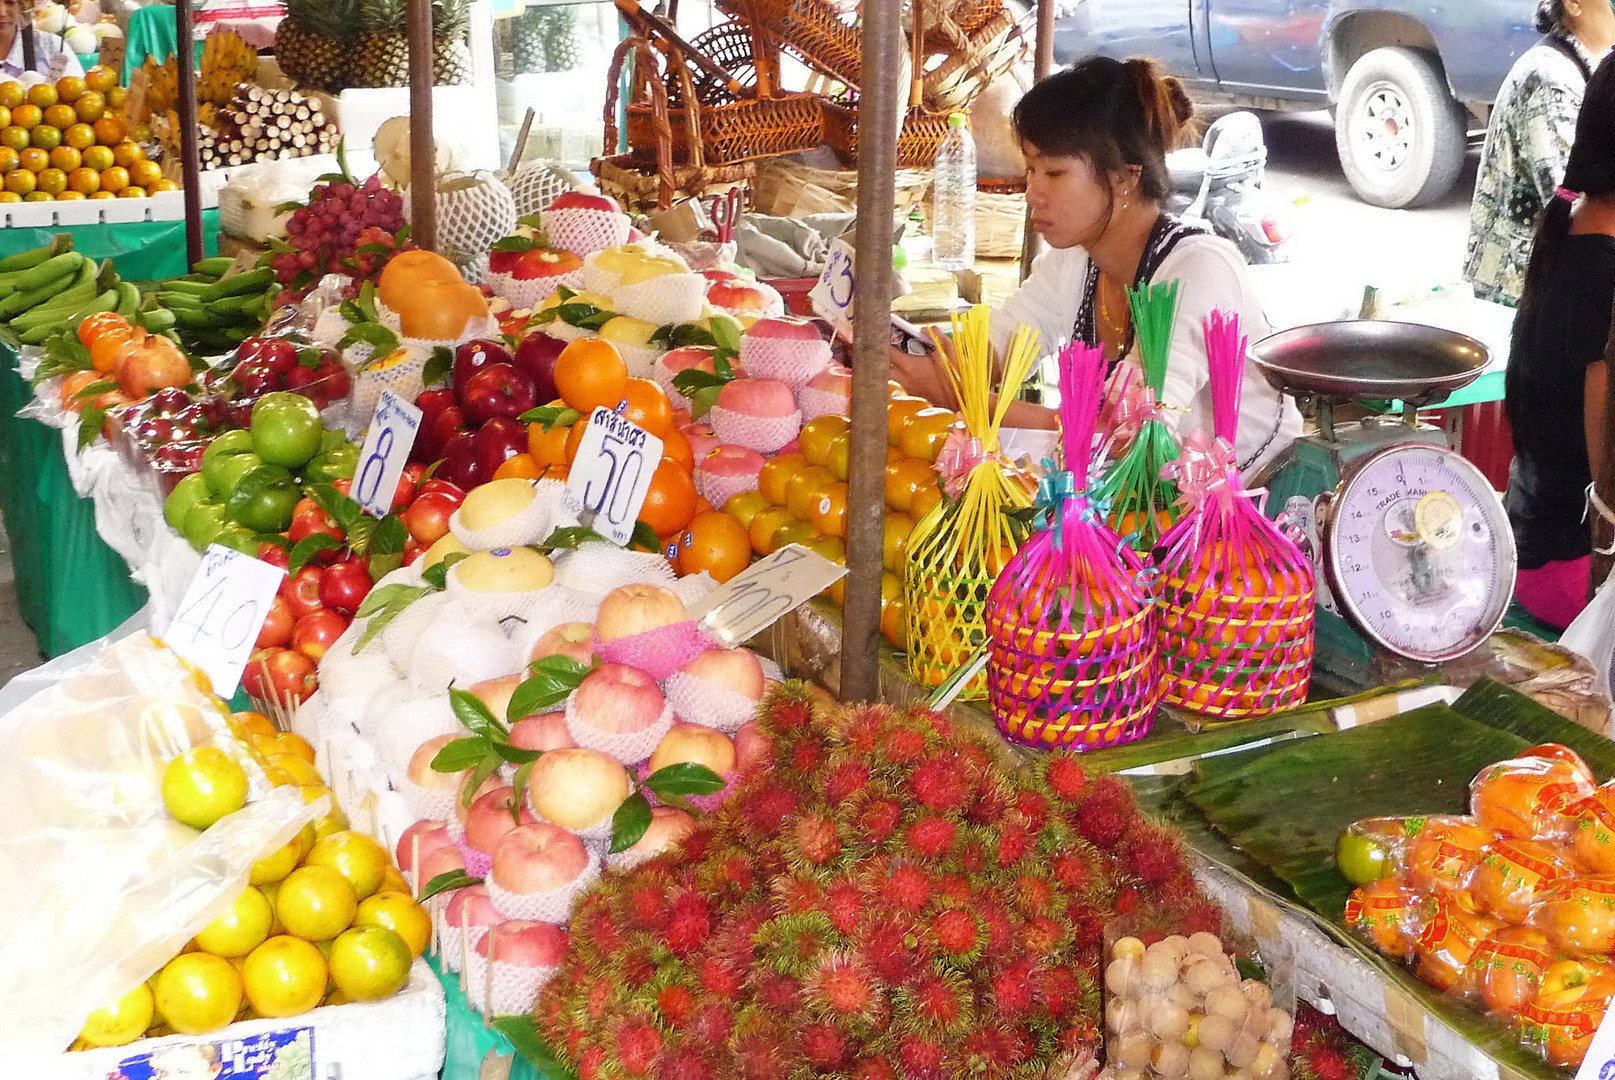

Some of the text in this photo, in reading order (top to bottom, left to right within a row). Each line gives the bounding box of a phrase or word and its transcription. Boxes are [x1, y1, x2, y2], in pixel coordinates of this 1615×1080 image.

[358, 427, 393, 505] 8
[584, 434, 643, 524] 50
[1367, 487, 1378, 496] 15
[1375, 491, 1401, 512] TRADE
[1351, 511, 1362, 520] 14
[1349, 534, 1360, 543] 13
[1351, 563, 1362, 572] 12
[1362, 591, 1371, 600] 11
[178, 576, 258, 650] 40
[1380, 610, 1392, 619] 10
